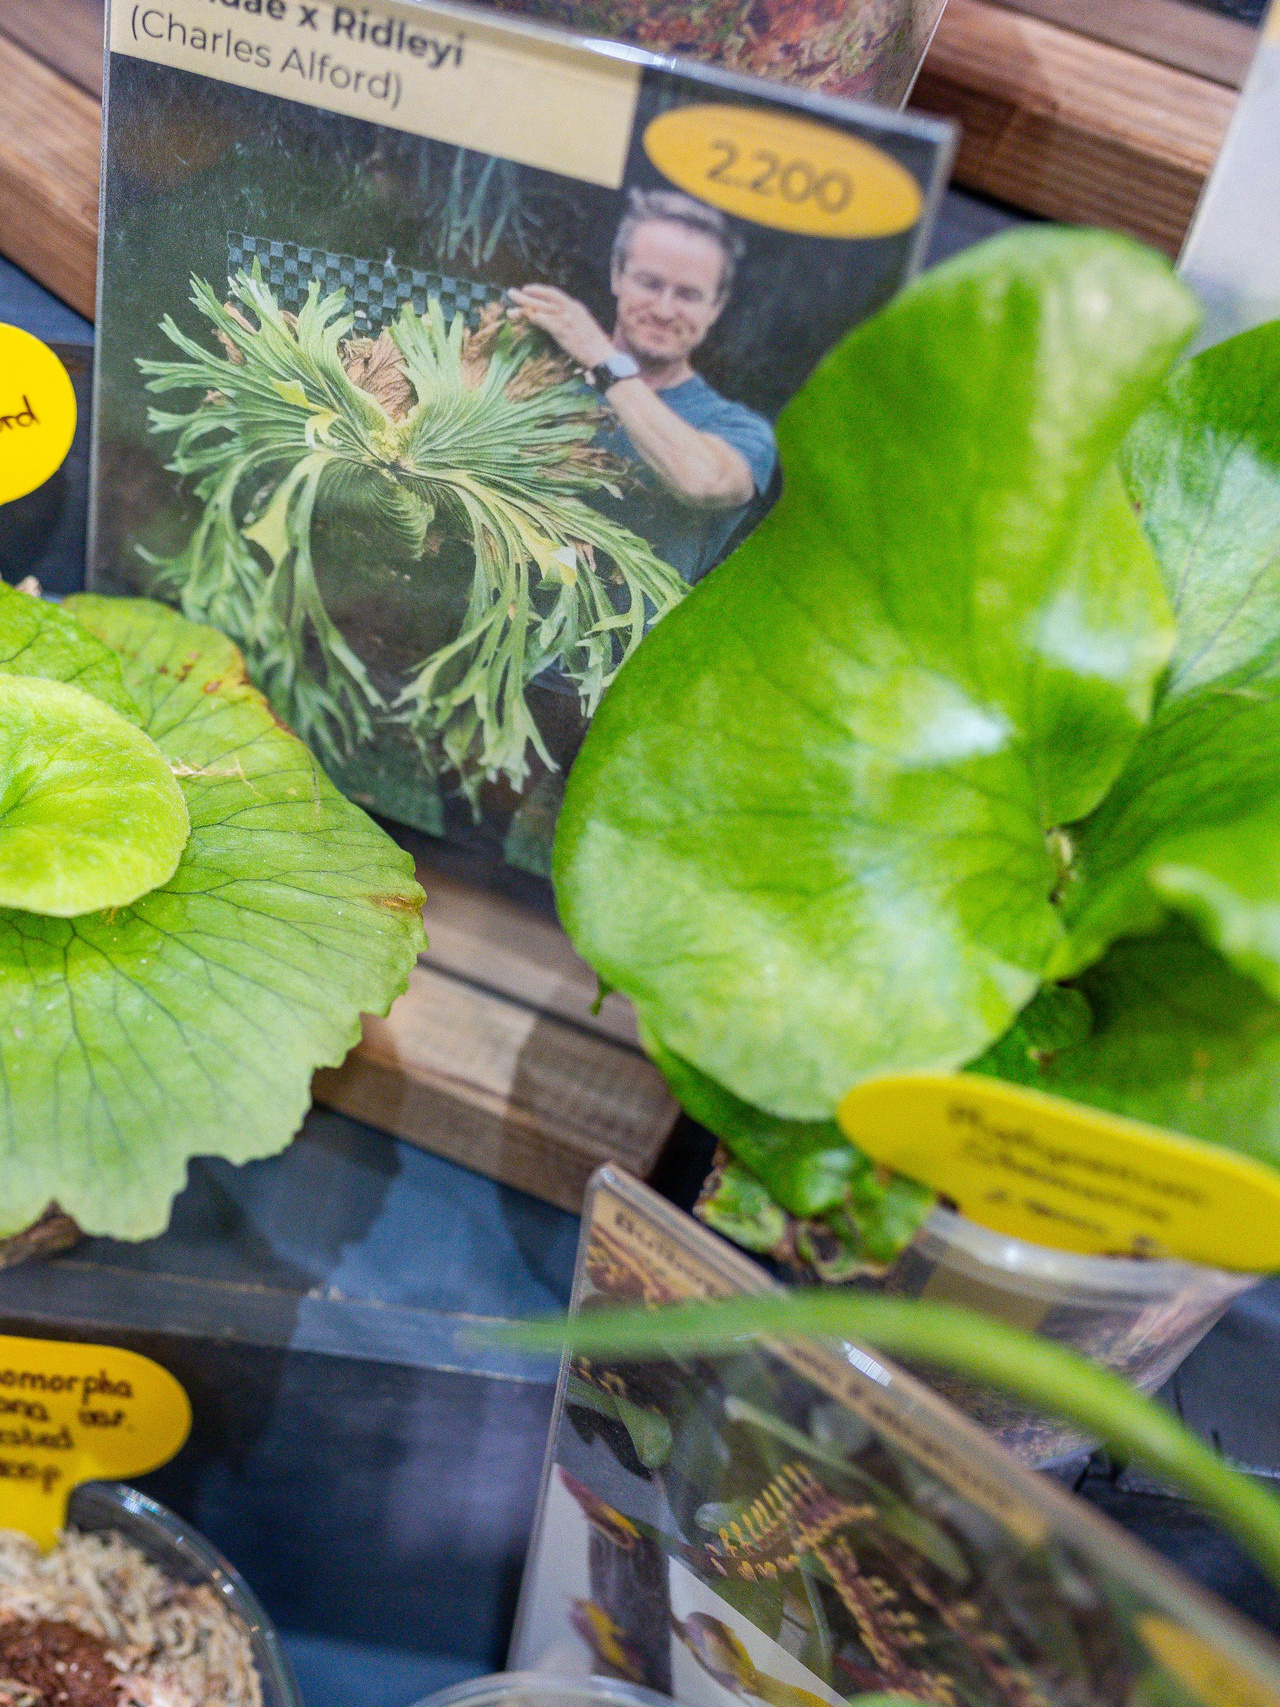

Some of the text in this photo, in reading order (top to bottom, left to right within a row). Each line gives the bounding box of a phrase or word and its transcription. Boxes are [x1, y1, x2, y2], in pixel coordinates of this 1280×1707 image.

[131, 5, 403, 111] (Charles Alford)
[299, 5, 320, 31] x
[332, 5, 470, 69] Ridleyi
[705, 138, 854, 214] 2.200
